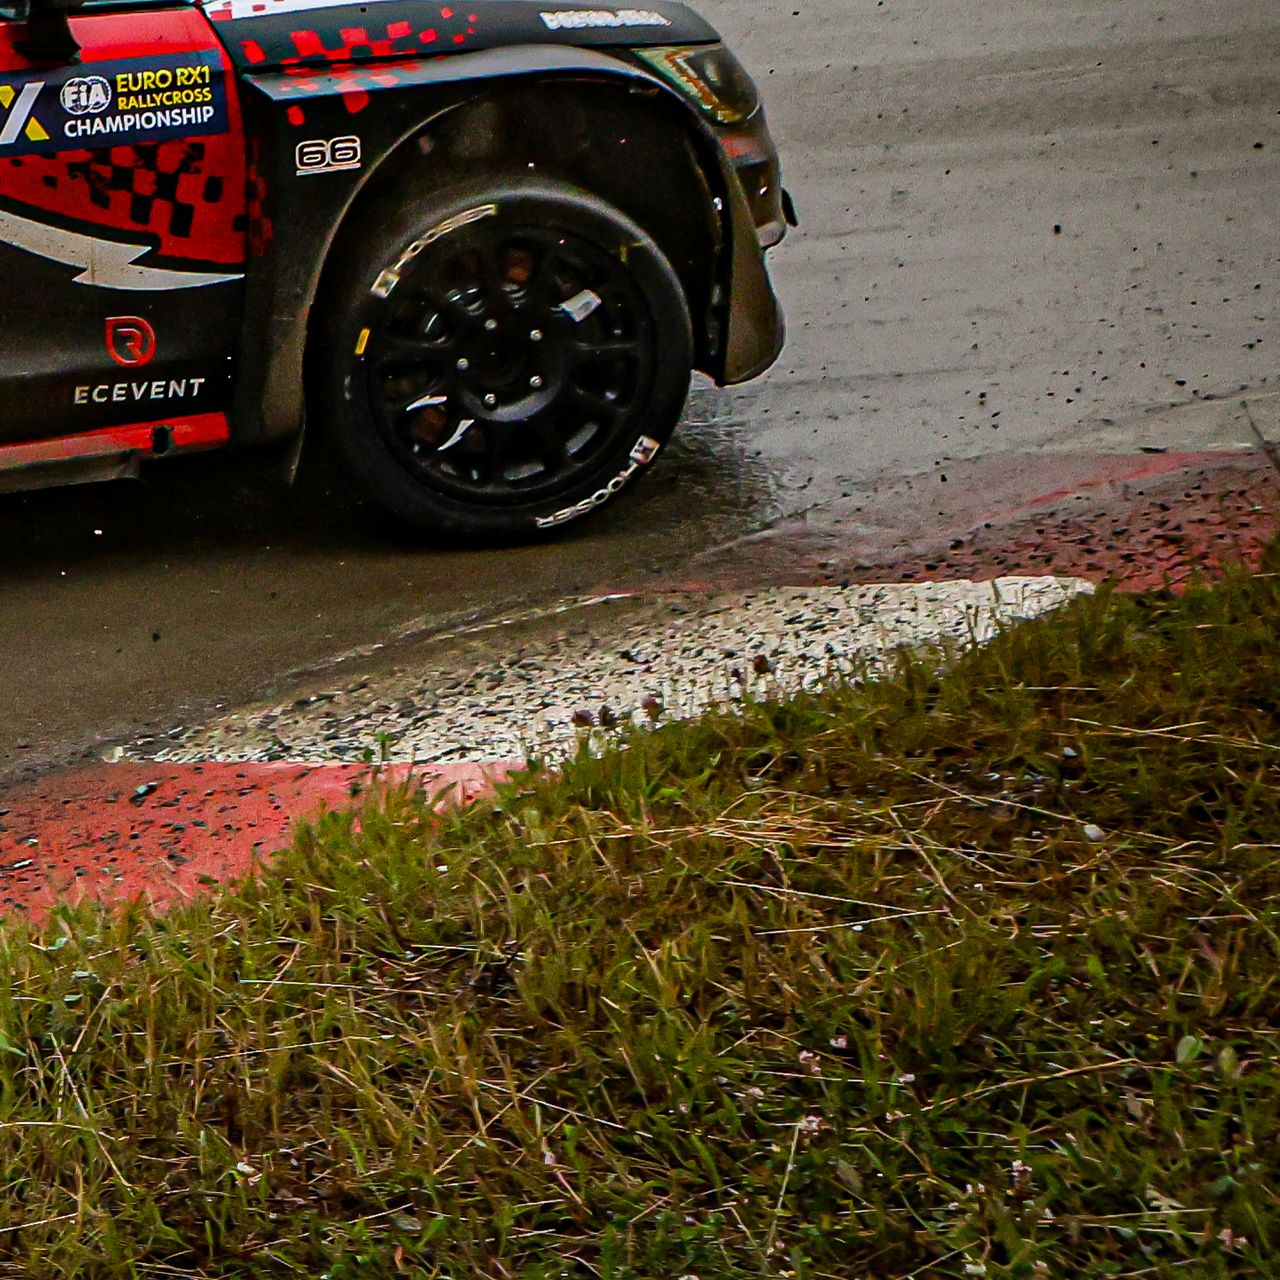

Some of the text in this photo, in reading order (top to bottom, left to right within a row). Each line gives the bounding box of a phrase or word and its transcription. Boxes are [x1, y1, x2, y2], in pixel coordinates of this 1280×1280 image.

[116, 65, 211, 92] EURO RX1
[117, 87, 213, 110] RALLYCROSS
[63, 105, 215, 138] CHAMPIONSHIP
[295, 135, 361, 170] 66
[73, 378, 206, 405] ECEVENT
